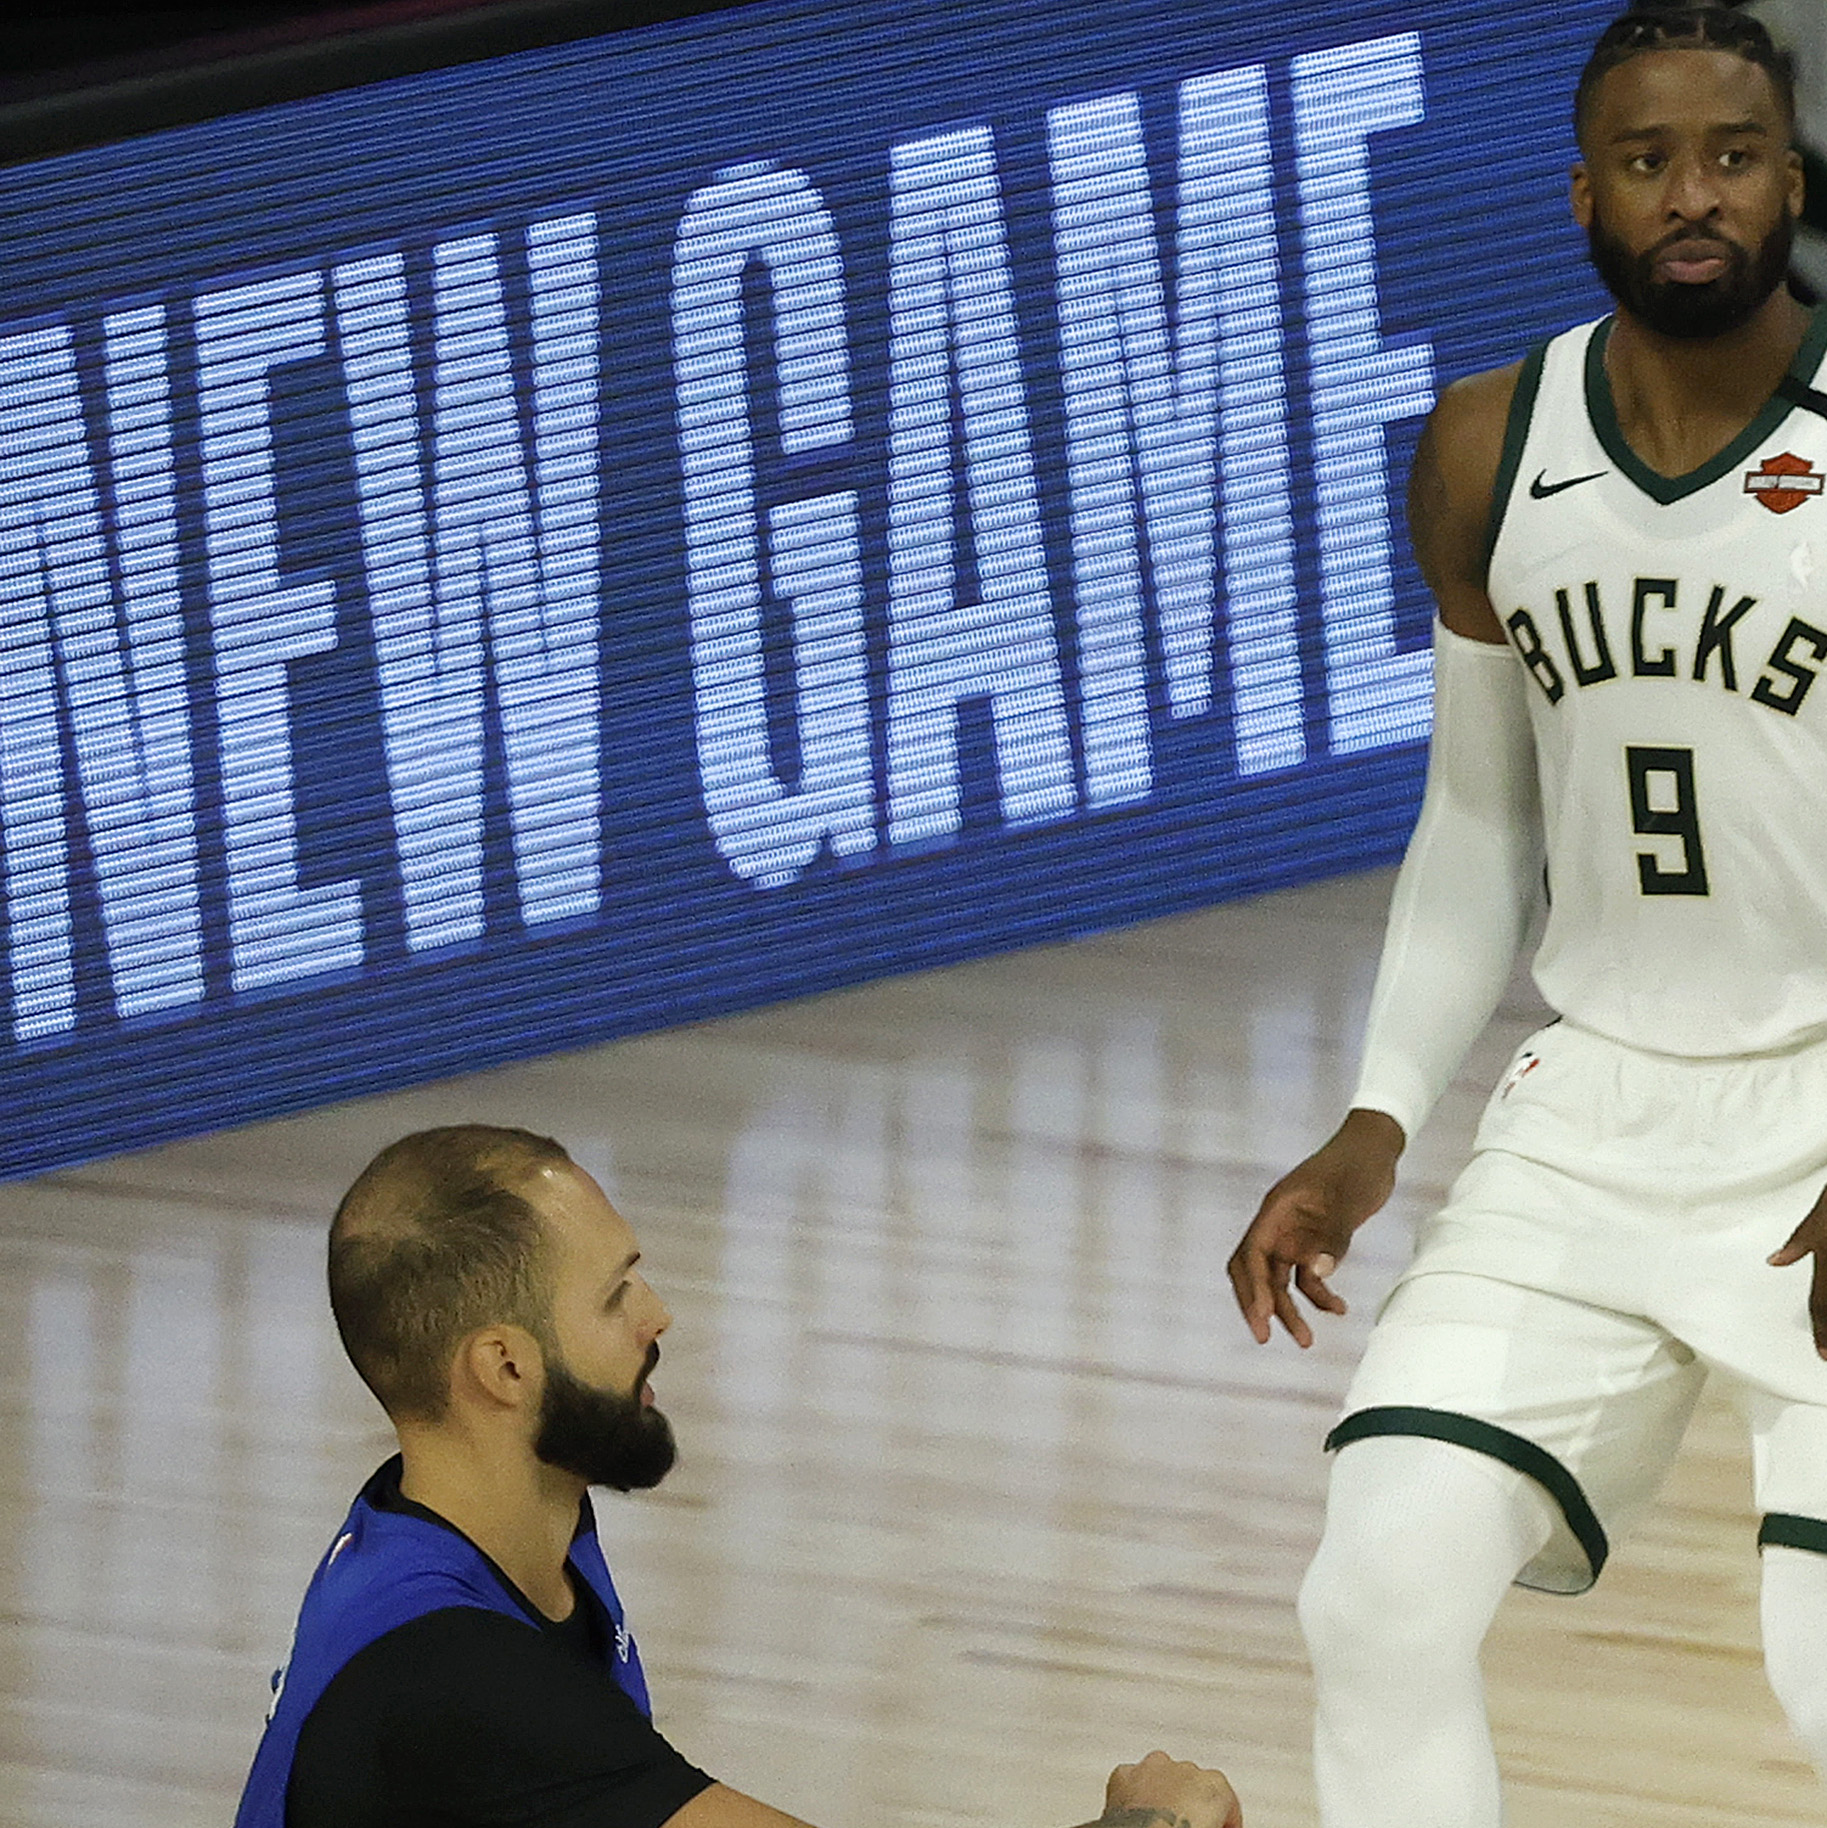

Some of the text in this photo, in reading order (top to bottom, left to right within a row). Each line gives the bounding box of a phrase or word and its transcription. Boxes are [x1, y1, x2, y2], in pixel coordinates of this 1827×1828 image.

[0, 31, 1437, 1042] NEW GAME
[1624, 744, 1711, 898] 9
